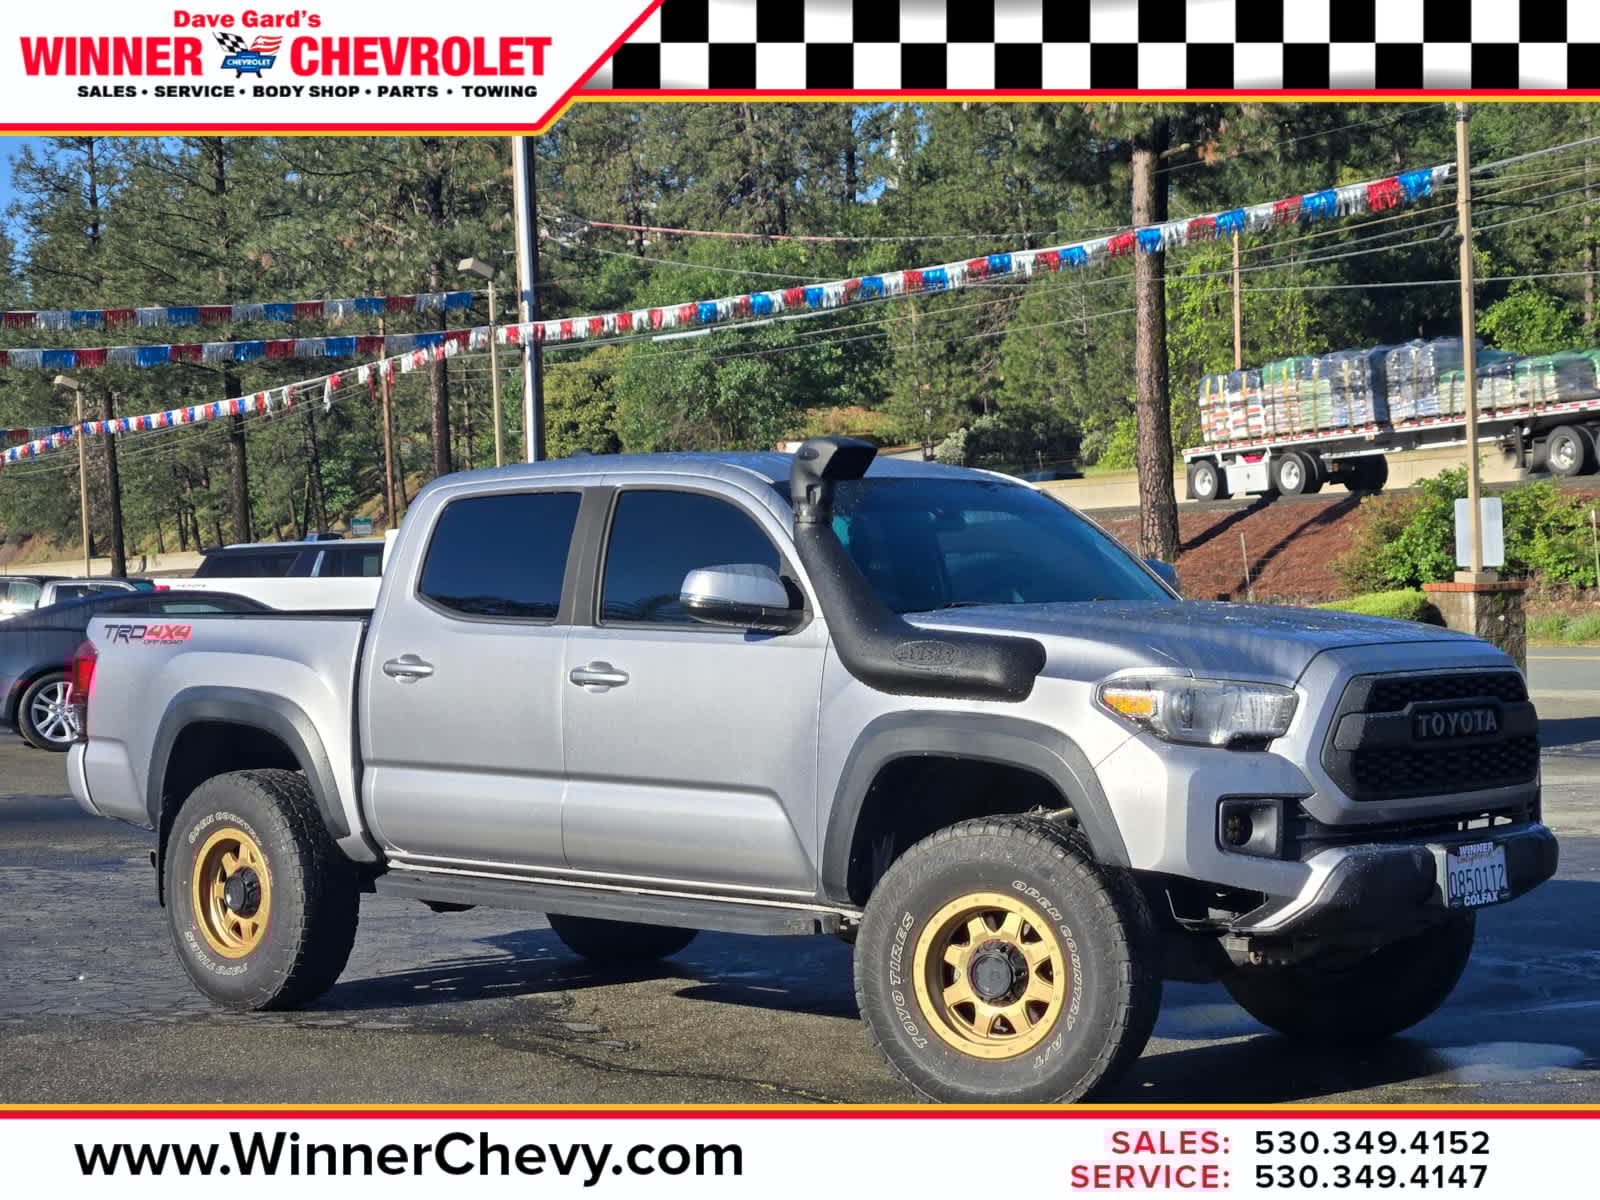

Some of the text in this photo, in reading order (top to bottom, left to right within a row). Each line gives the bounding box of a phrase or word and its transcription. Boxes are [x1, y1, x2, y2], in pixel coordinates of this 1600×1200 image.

[104, 624, 147, 644] TRD
[1416, 709, 1498, 737] TOYOTA
[1459, 842, 1494, 856] WINNER
[1464, 891, 1498, 906] COLFAX
[1012, 880, 1063, 921] OPEN
[1060, 924, 1083, 1031] COUNTRY
[889, 911, 929, 1049] TOYO TIRES
